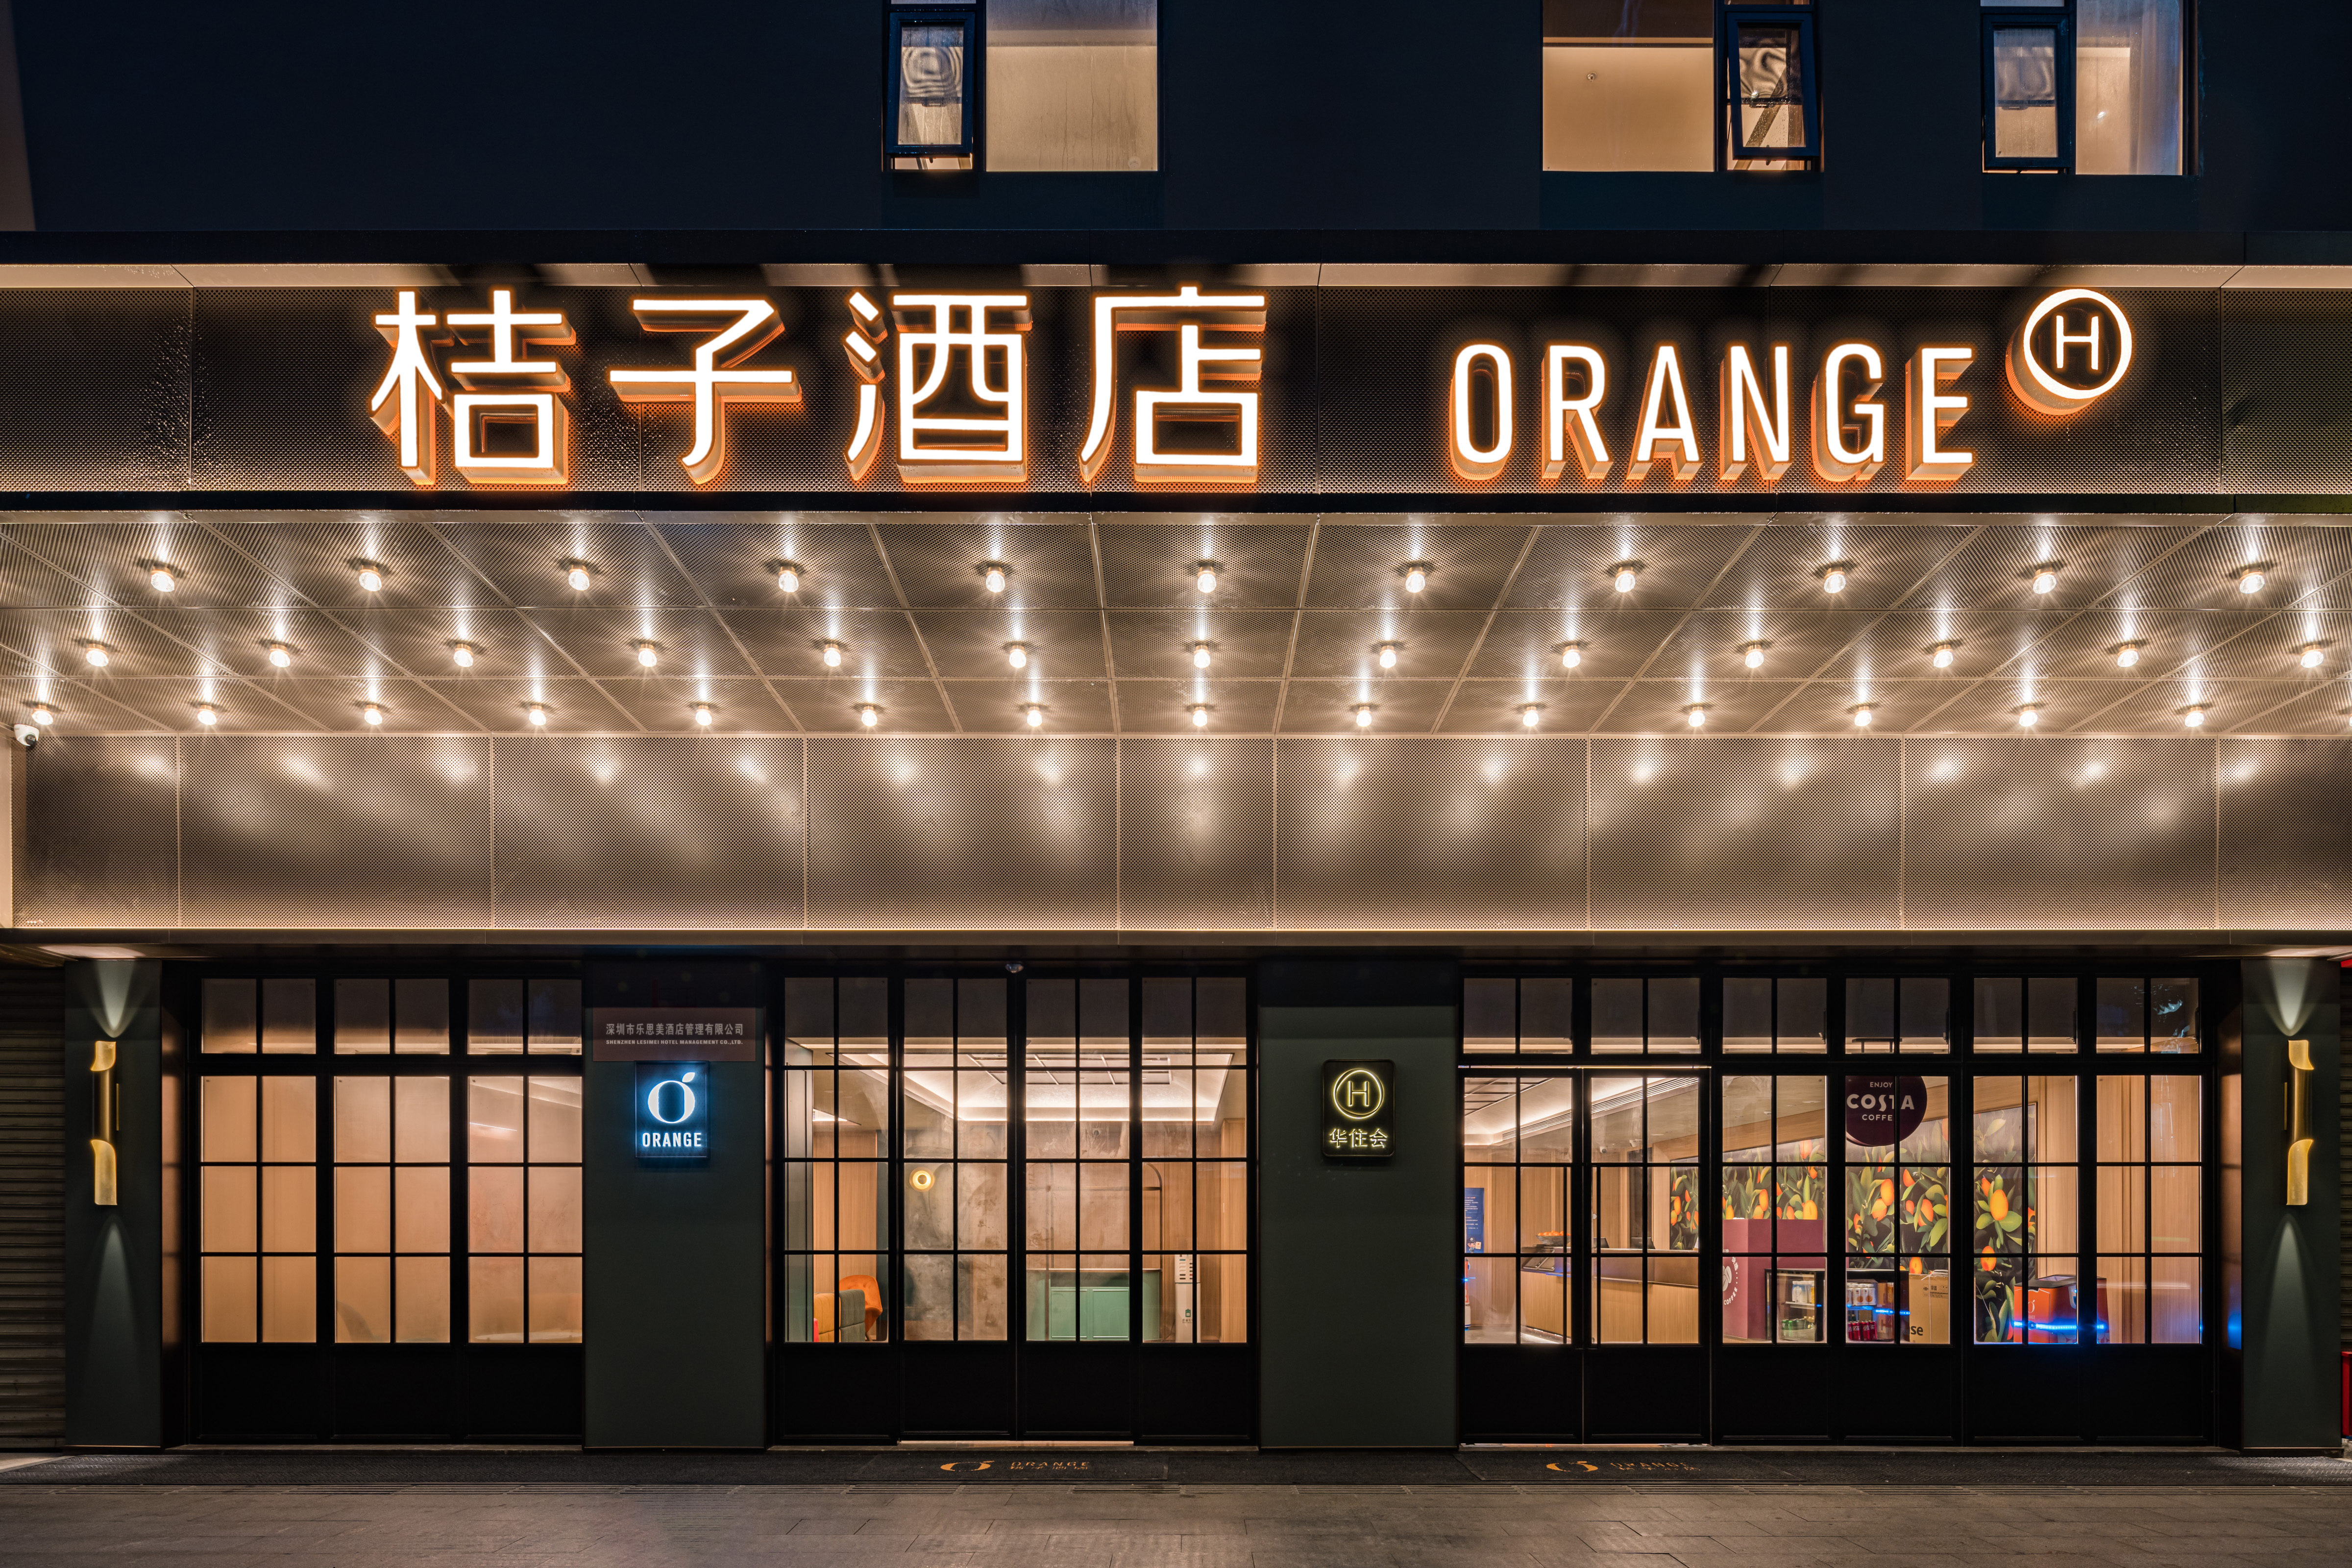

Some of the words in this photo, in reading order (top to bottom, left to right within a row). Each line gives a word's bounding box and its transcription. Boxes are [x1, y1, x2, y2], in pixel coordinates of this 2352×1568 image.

[371, 287, 1265, 470] 桔子酒店
[1454, 344, 1973, 464] ORANGE
[606, 1023, 743, 1035] 深圳市乐思美酒店管理有限公司
[1846, 1094, 1914, 1112] COSTA
[642, 1132, 701, 1147] ORANGE
[1329, 1128, 1388, 1148] 华住会
[1724, 1287, 1738, 1305] COFFEE
